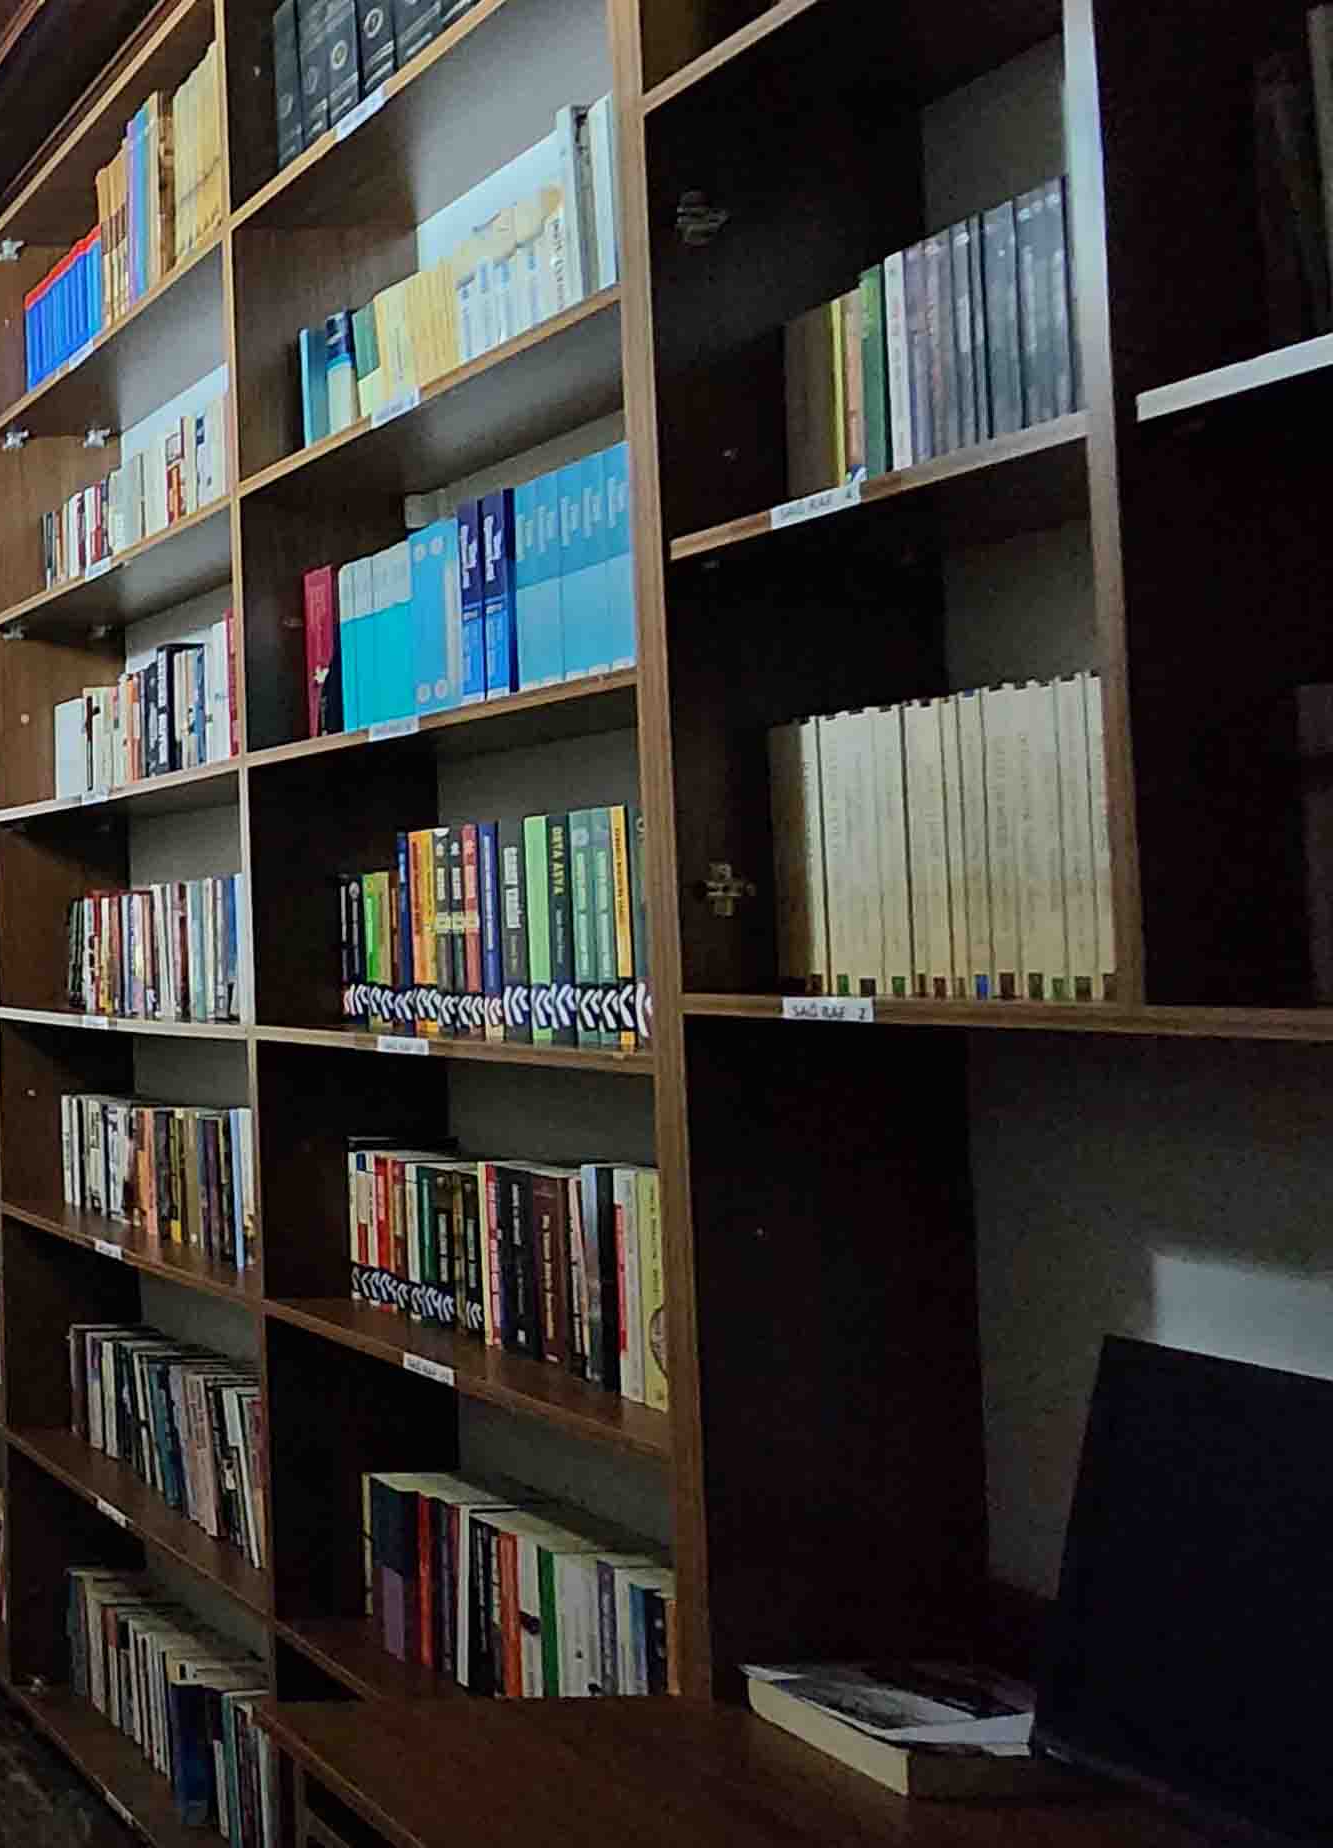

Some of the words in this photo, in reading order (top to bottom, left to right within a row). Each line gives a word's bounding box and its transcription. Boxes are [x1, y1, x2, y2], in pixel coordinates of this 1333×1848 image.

[551, 826, 564, 861] ORTA
[552, 864, 566, 896] ASYA
[789, 1002, 818, 1018] SAĞ
[821, 1006, 846, 1019] RAF
[857, 1007, 866, 1020] 2
